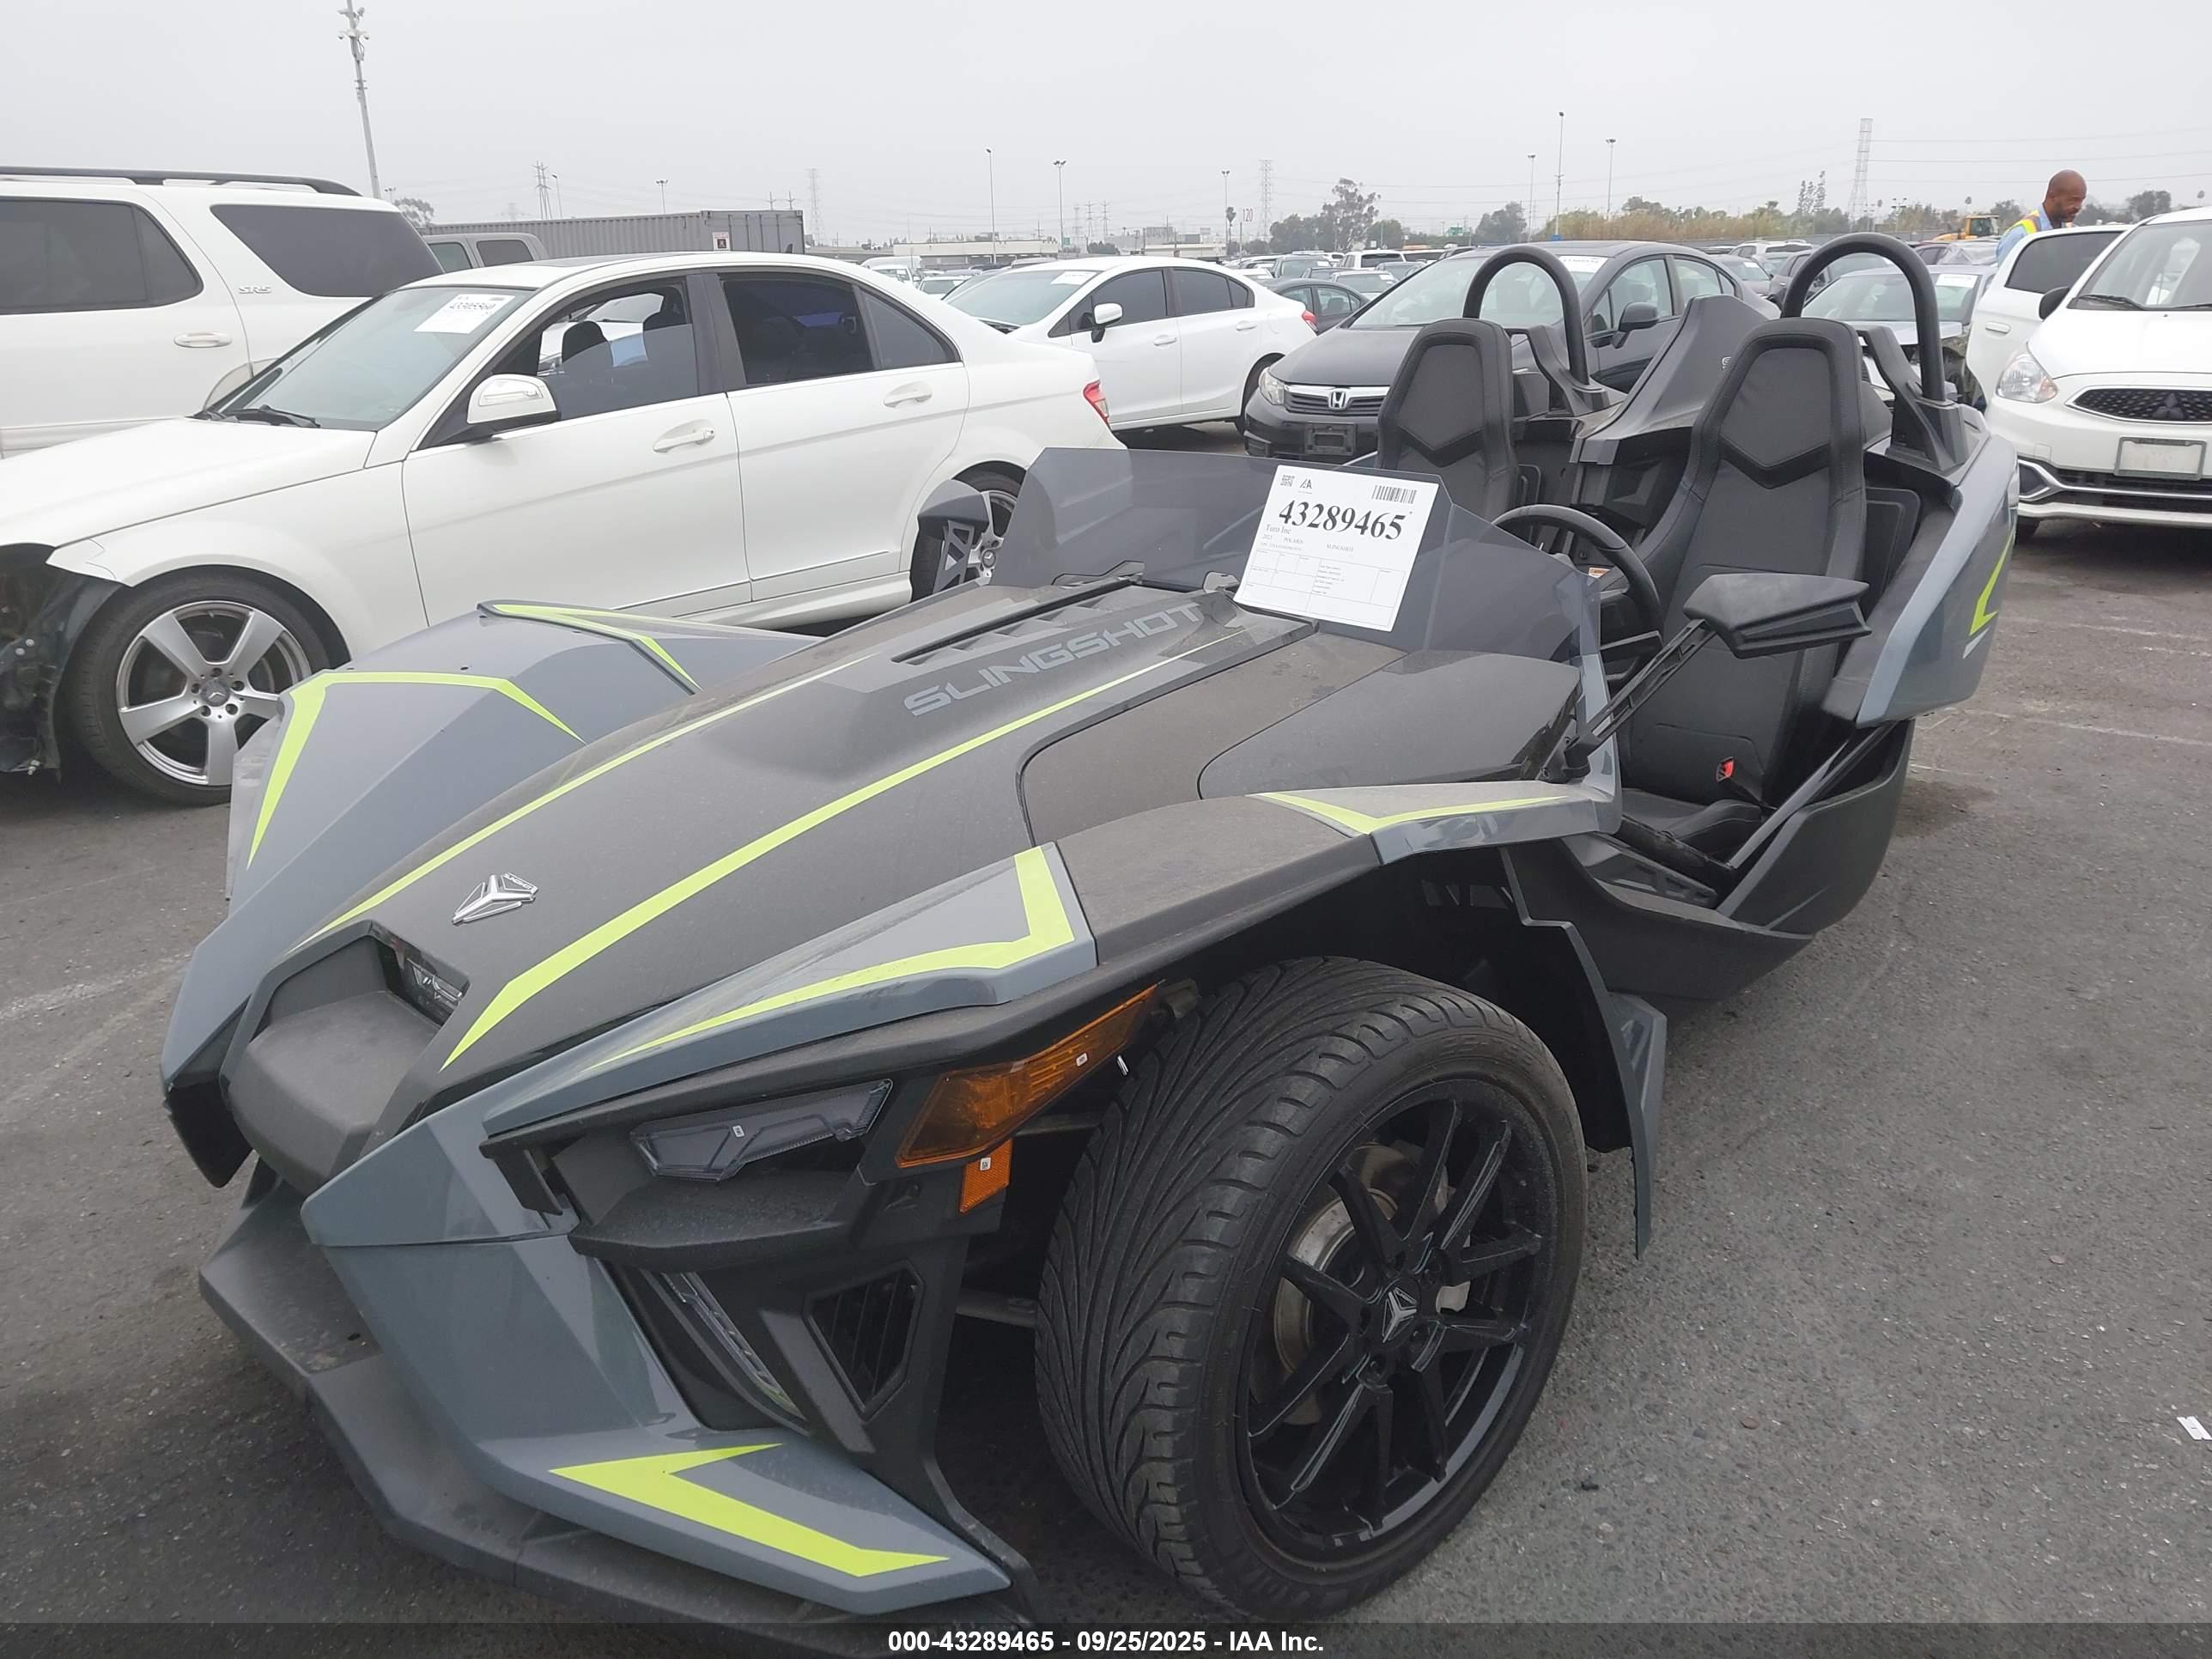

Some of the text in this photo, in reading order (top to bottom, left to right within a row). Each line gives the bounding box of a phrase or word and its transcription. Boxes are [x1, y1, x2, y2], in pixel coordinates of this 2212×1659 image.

[239, 285, 271, 295] SR5
[1279, 500, 1406, 540] 43289465
[1281, 526, 1291, 534] Inc
[904, 602, 1201, 717] SLINGSHOT
